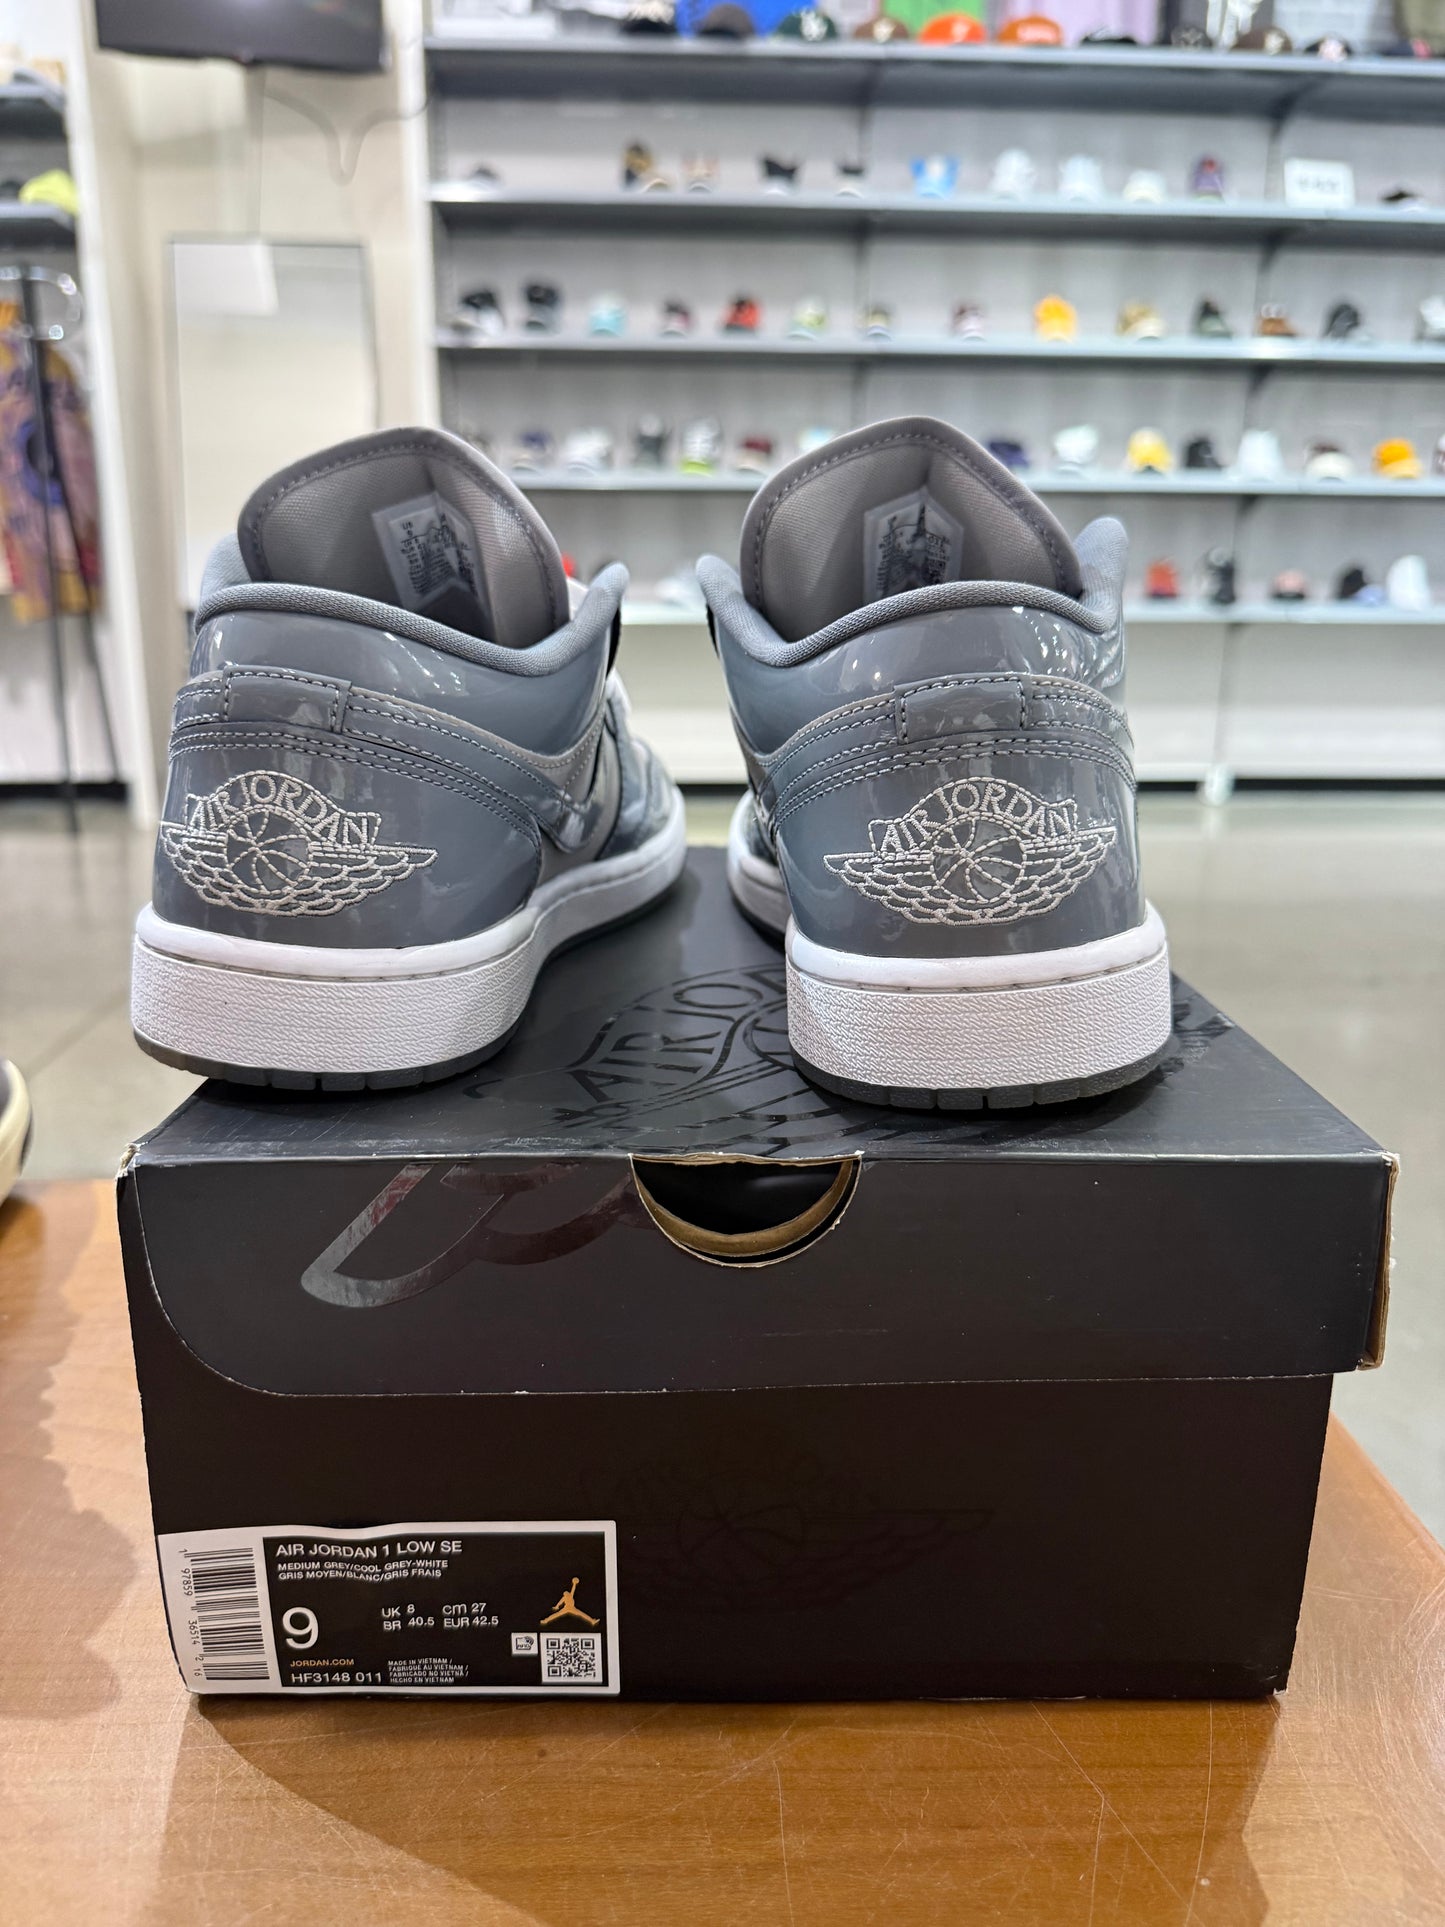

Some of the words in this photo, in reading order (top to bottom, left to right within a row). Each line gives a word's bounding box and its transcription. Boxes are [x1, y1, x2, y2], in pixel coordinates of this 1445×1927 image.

[190, 791, 239, 834] AIR
[242, 775, 370, 846] JORDAN
[880, 809, 941, 854] AIR
[936, 782, 1078, 838] JORDAN
[276, 1543, 305, 1557] AIR
[309, 1544, 378, 1558] JORDAN
[382, 1544, 390, 1557] 1
[396, 1540, 435, 1555] LOW
[440, 1540, 463, 1553] SE
[277, 1561, 321, 1571] MEDIUM
[324, 1561, 382, 1572] GREY/COOL
[384, 1559, 448, 1571] GREY-WHITE
[278, 1571, 304, 1580] GRIS
[305, 1569, 409, 1582] MOYEN/BLANC/GRIS
[411, 1568, 442, 1577] FRAIS
[180, 1568, 192, 1596] 97859
[188, 1620, 199, 1645] 36514
[381, 1606, 401, 1618] UK
[407, 1603, 415, 1615] 8
[471, 1602, 487, 1614] 27
[282, 1606, 319, 1650] 9
[383, 1620, 402, 1631] BR
[407, 1616, 435, 1627] 40.5
[443, 1616, 470, 1628] EUR
[472, 1615, 499, 1626] 42.5
[290, 1658, 355, 1668] JORDAN.COM
[291, 1672, 351, 1683] HF3148
[355, 1671, 382, 1683] 011
